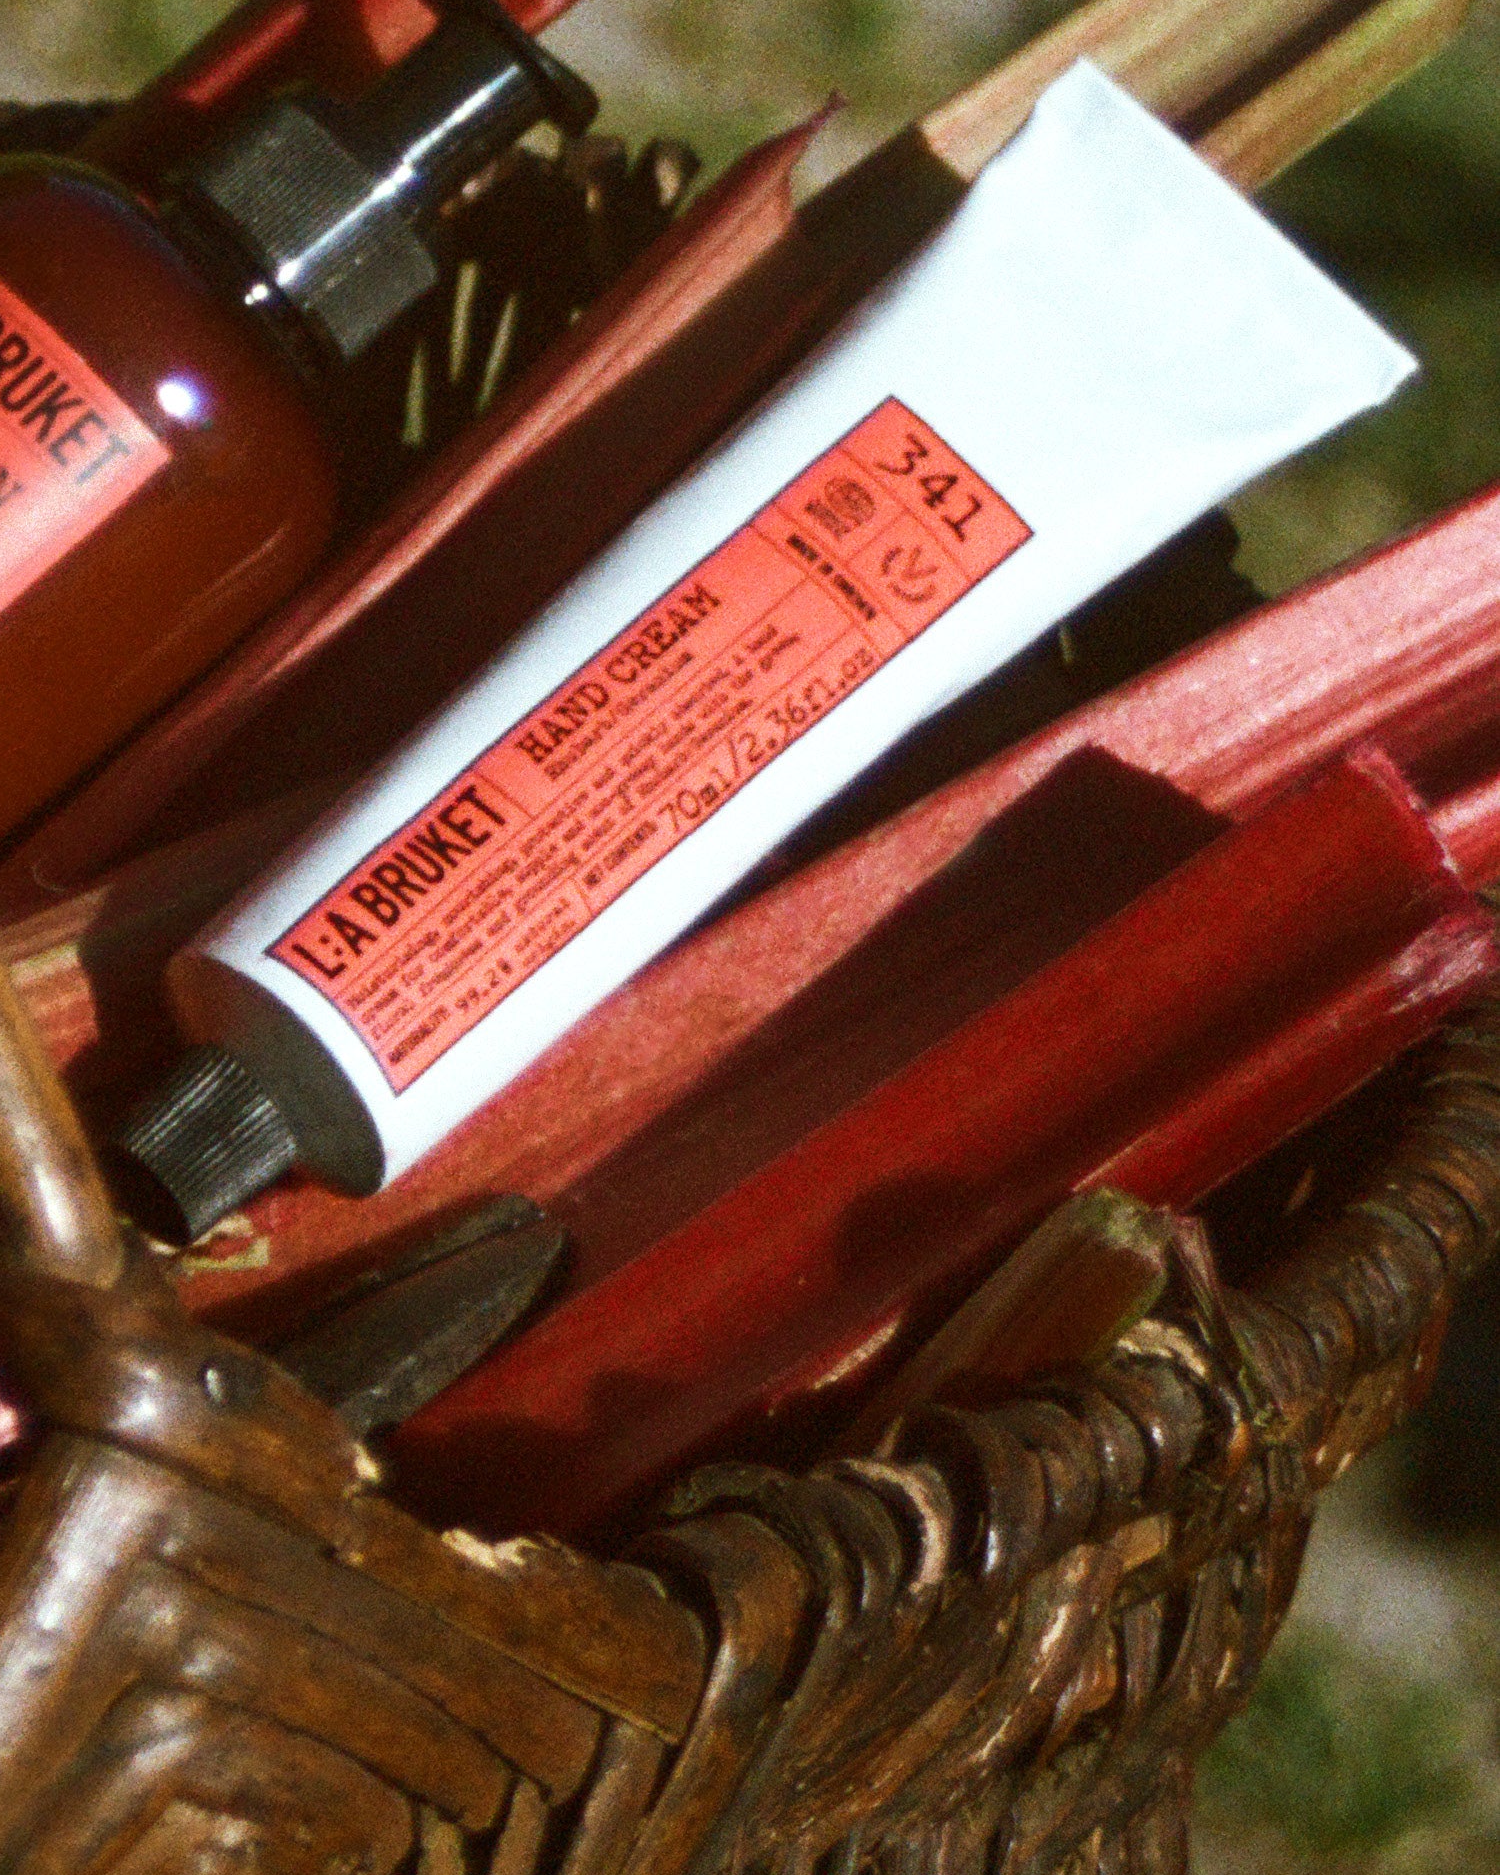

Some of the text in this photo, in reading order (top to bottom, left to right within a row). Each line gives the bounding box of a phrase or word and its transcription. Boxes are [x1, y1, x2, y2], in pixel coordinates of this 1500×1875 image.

[874, 434, 989, 542] 341
[517, 584, 722, 766] HAND CREAM
[291, 783, 507, 980] L:A BRUKET
